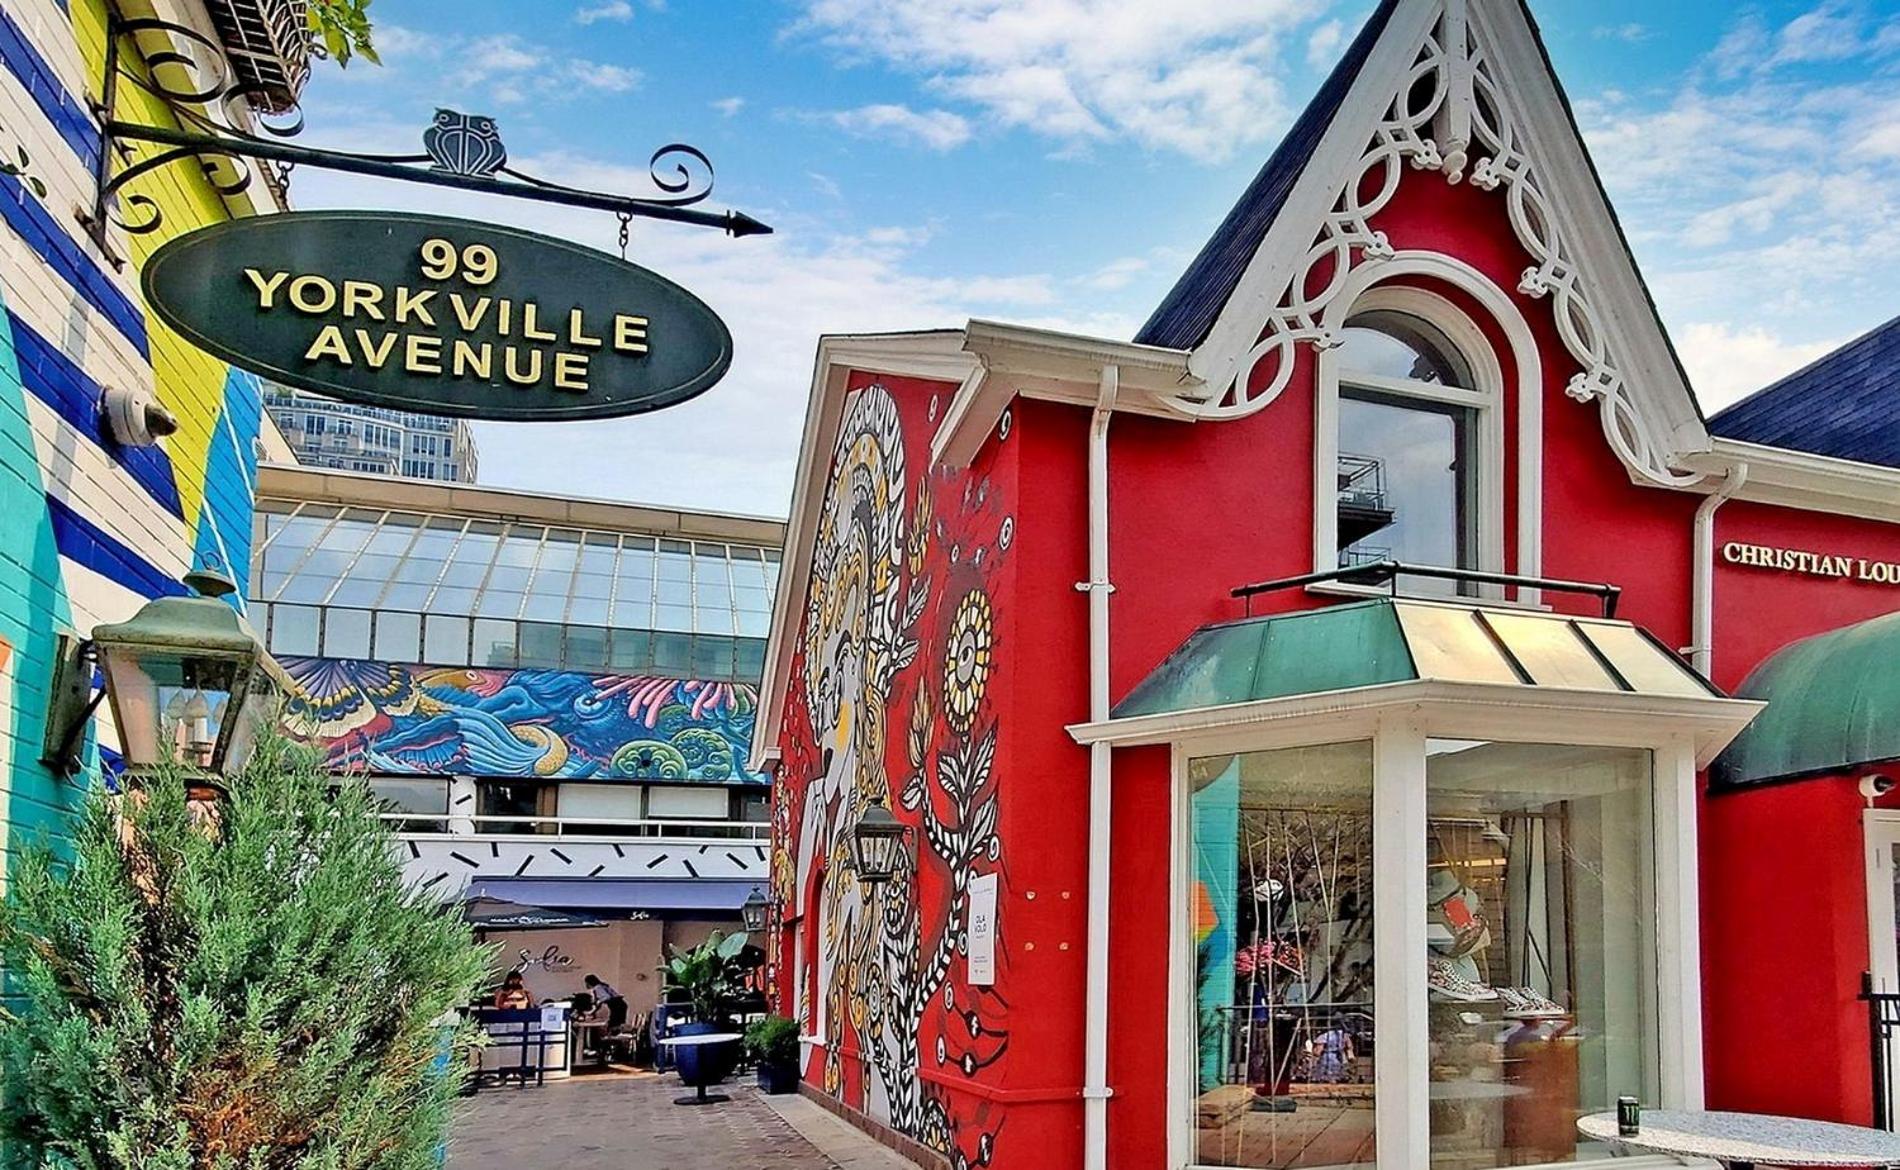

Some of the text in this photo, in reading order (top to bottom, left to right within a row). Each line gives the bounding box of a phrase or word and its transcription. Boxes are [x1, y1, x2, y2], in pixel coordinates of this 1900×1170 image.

[421, 238, 498, 285] 99
[244, 268, 650, 353] YORKVILLE
[305, 324, 590, 391] AVENUE
[1723, 542, 1852, 577] CHRISTIAN
